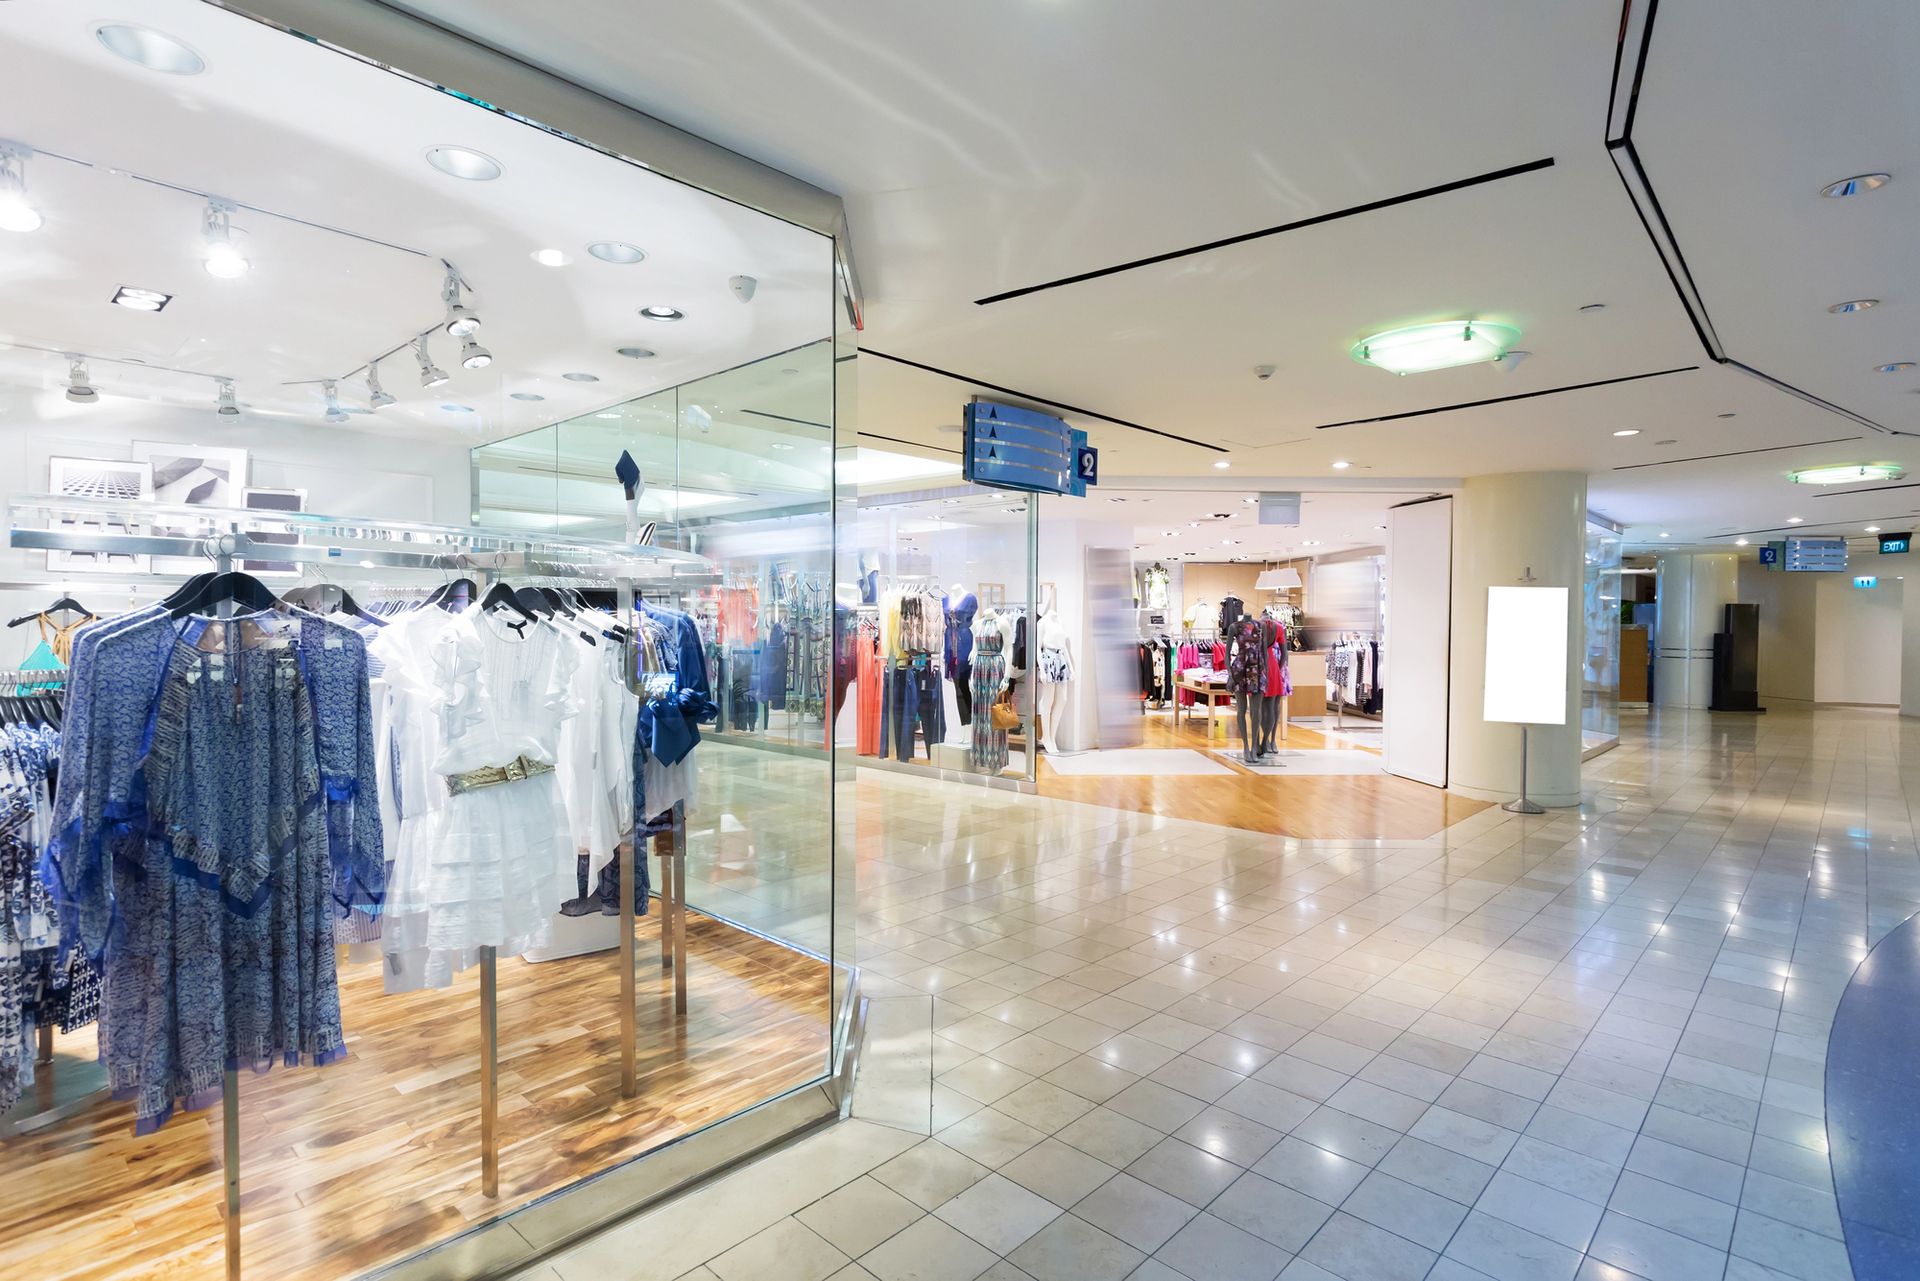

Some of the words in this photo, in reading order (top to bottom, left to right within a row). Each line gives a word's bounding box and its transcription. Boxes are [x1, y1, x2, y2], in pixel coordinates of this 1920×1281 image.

[1082, 453, 1094, 477] 2
[1883, 541, 1901, 552] EXIT
[1766, 551, 1774, 562] 2
